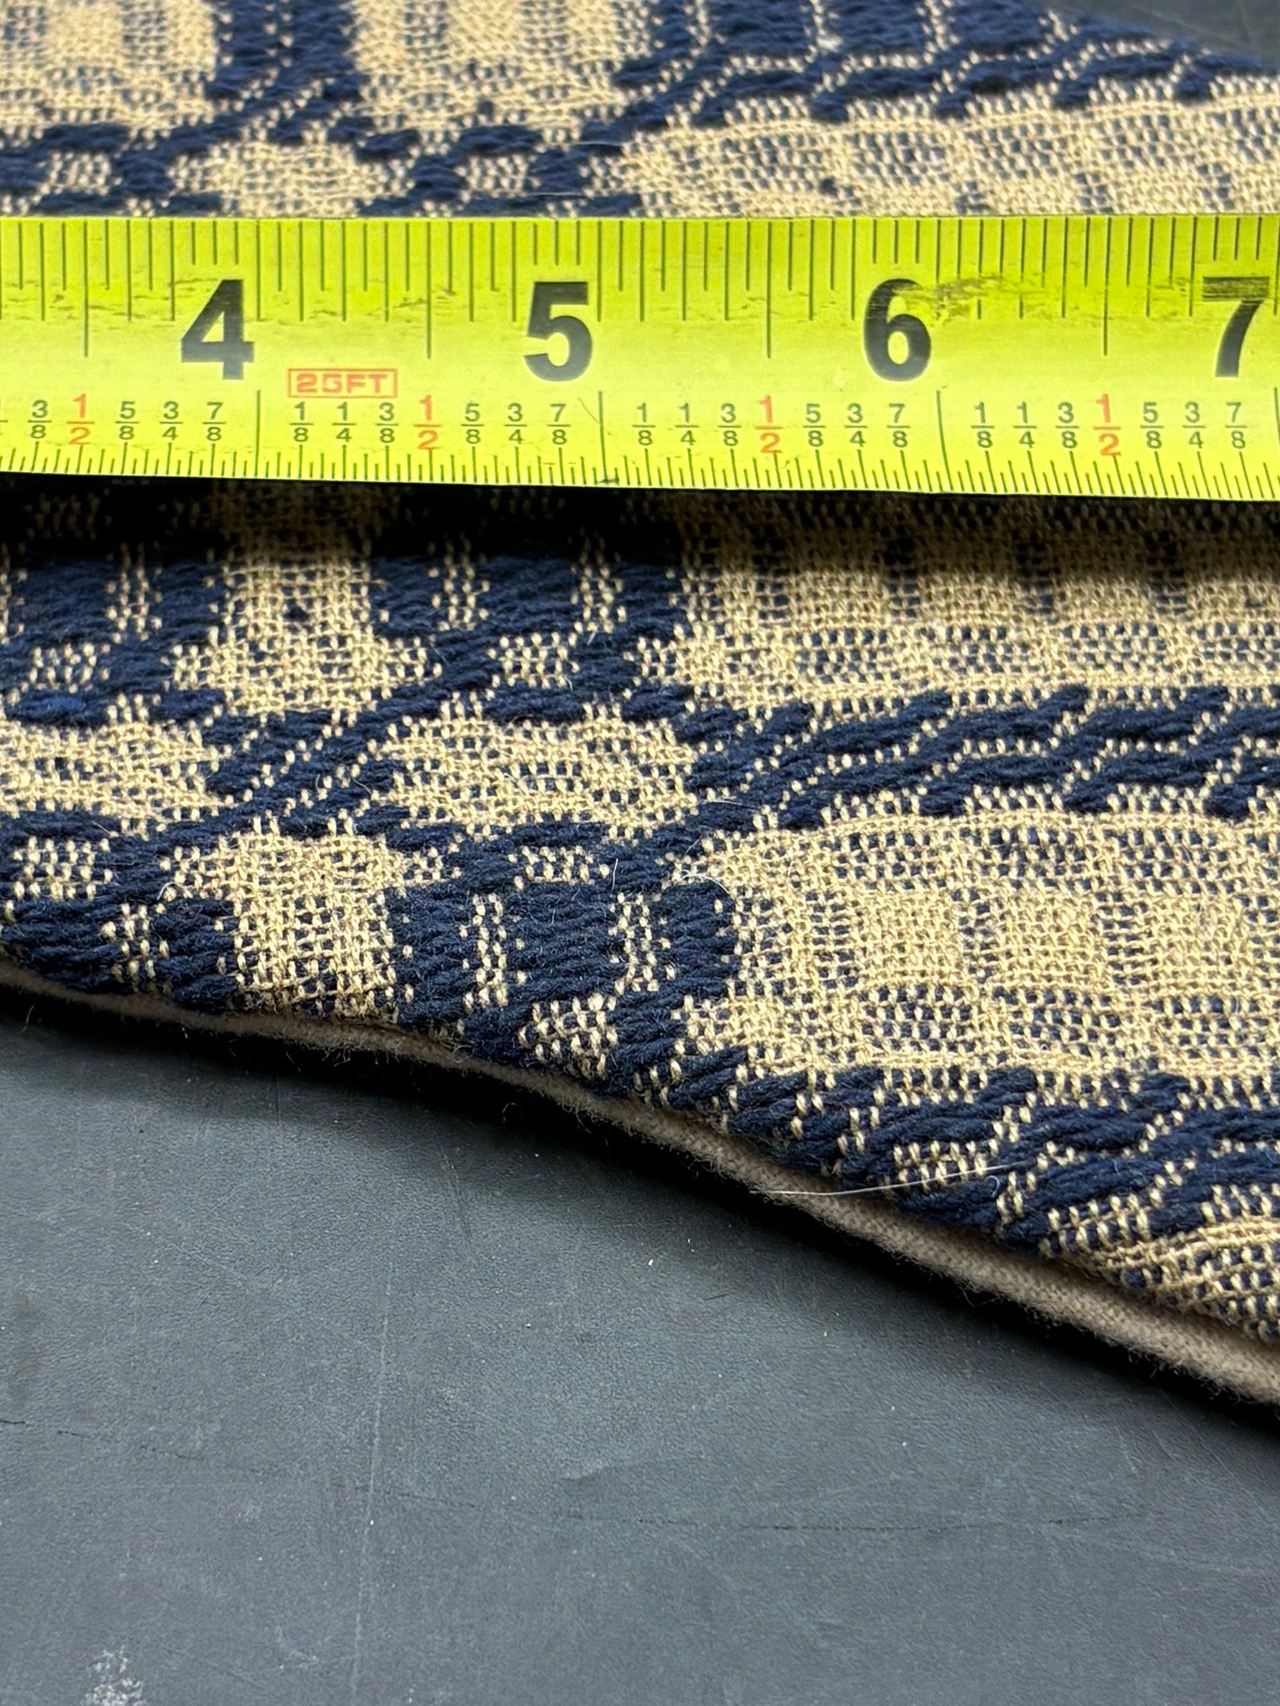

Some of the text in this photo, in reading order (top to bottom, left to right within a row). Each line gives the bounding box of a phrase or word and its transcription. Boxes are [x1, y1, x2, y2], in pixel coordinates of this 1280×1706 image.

[180, 278, 255, 380] 4
[523, 280, 593, 382] 5
[863, 277, 932, 382] 6
[1201, 275, 1271, 378] 7
[295, 372, 389, 394] 25FT
